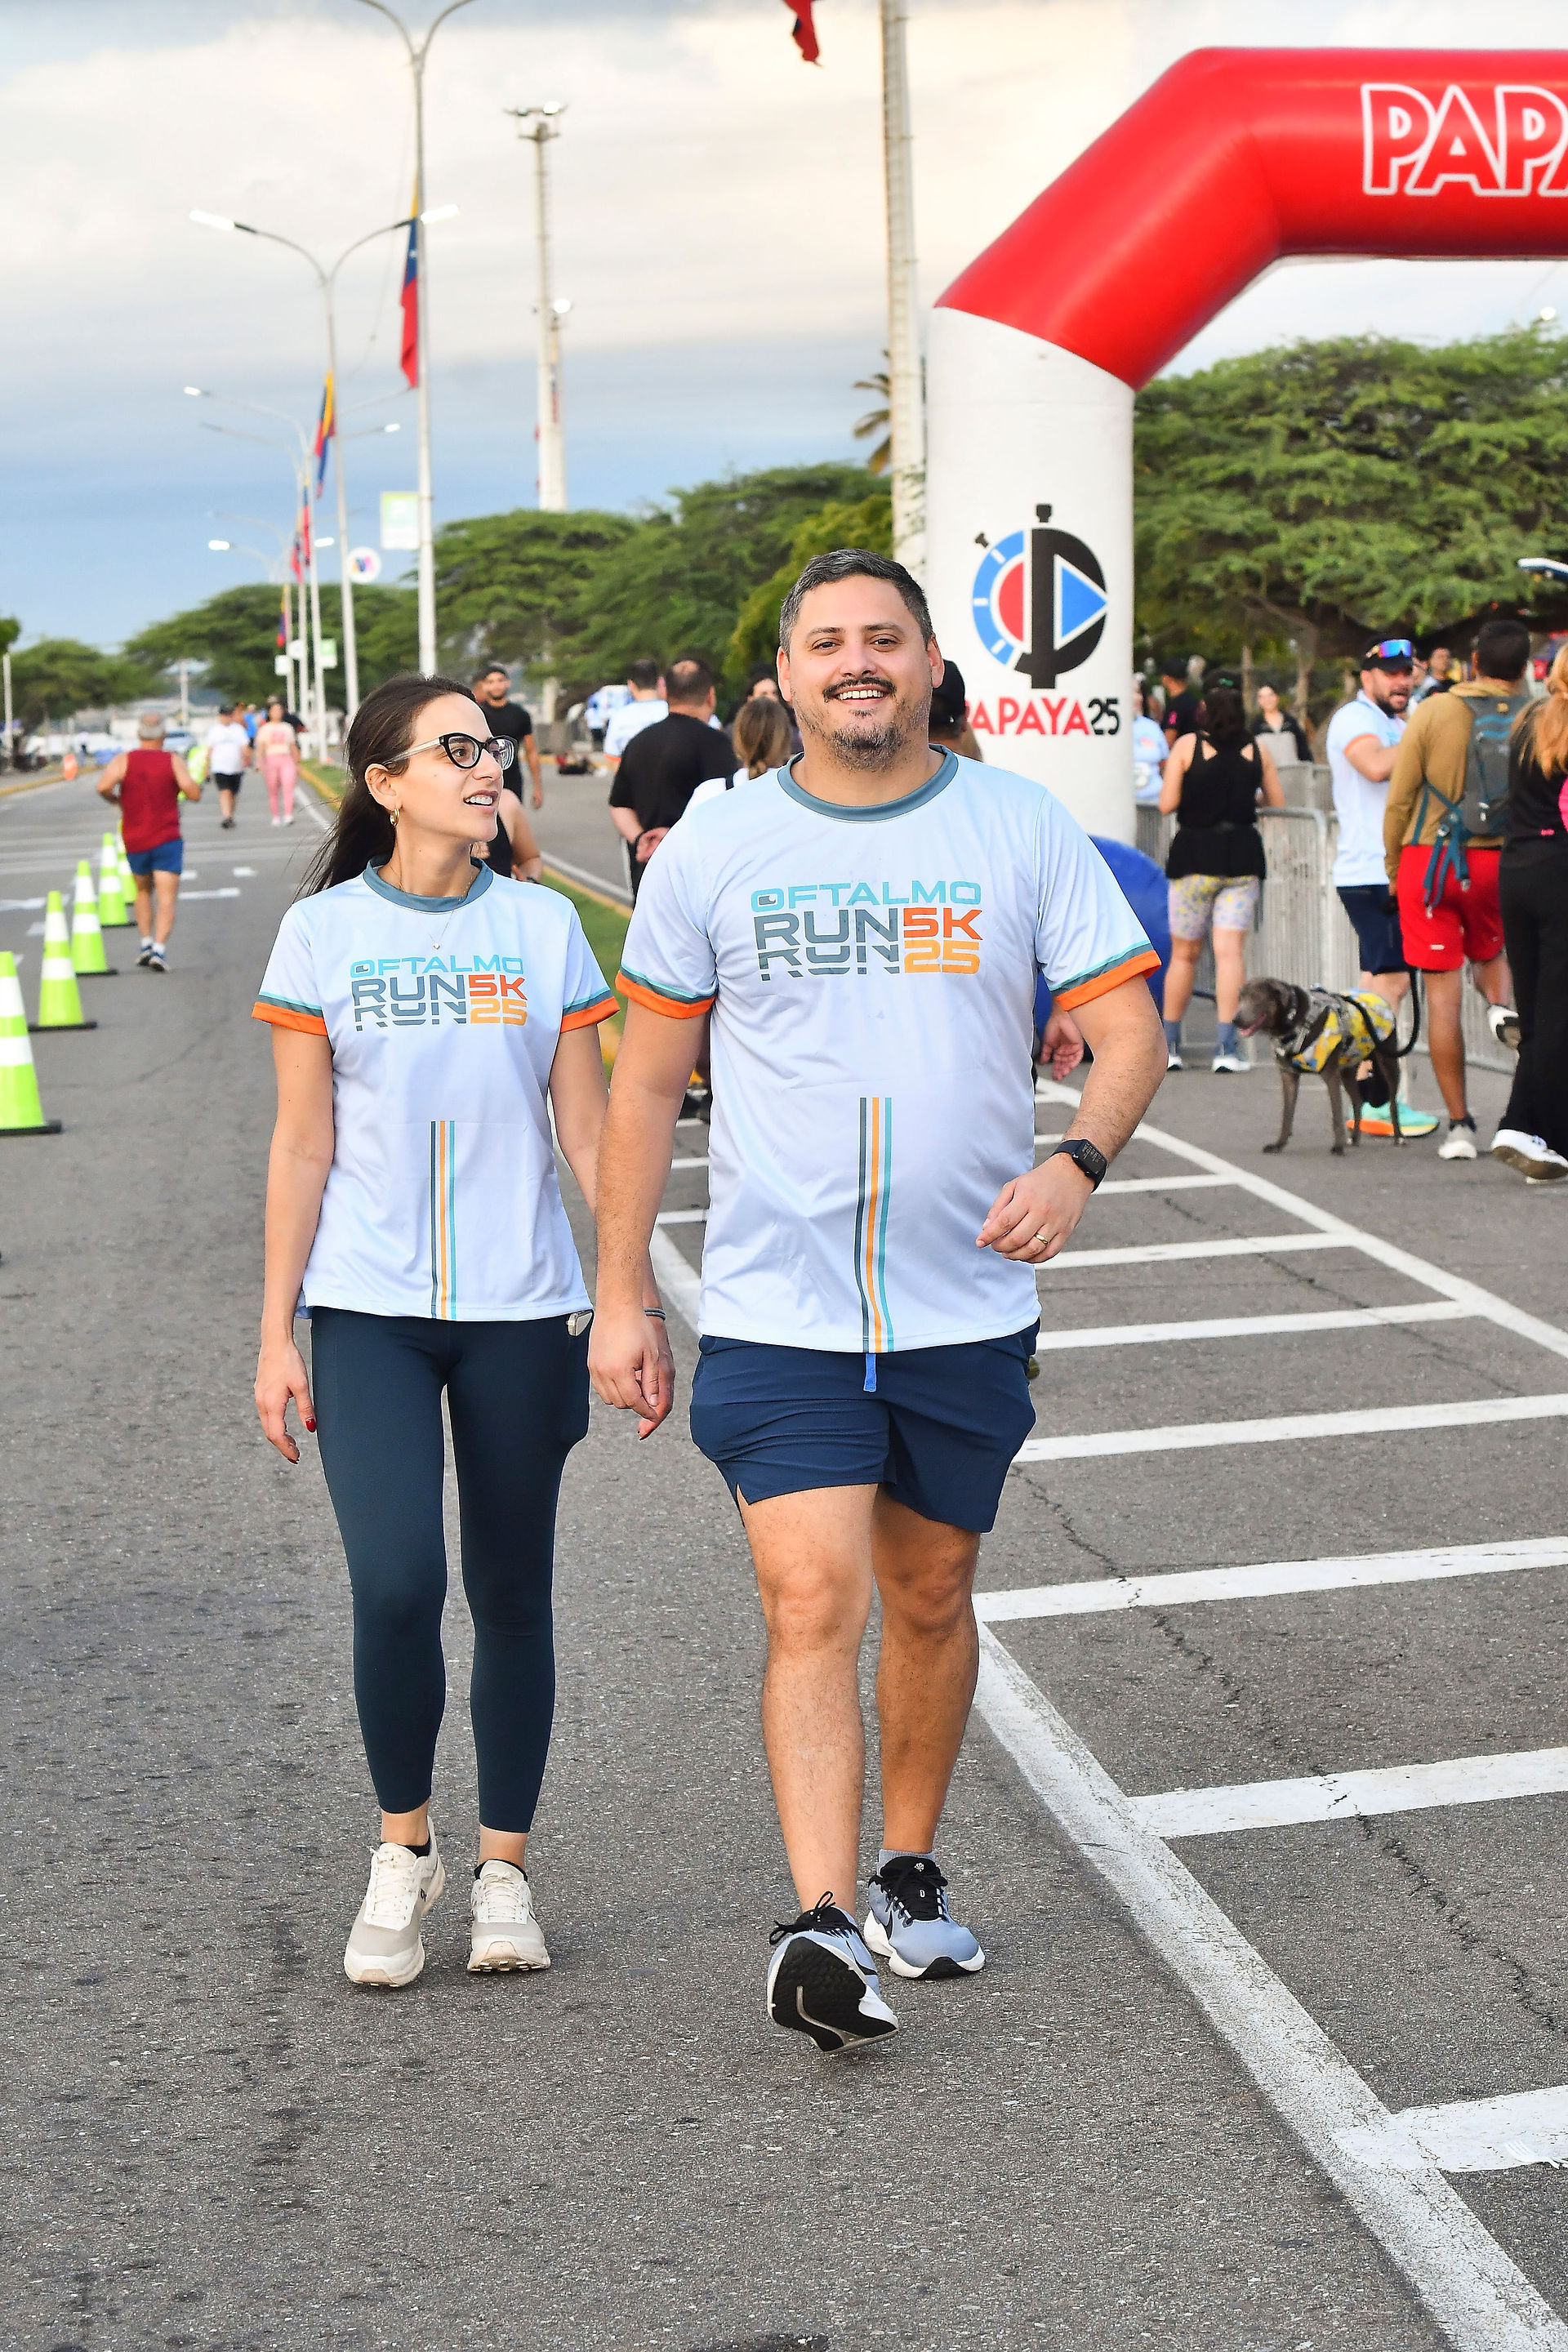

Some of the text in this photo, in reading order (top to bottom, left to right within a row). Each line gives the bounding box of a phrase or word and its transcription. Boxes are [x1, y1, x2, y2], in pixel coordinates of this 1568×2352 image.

[1361, 83, 1568, 197] PAP
[964, 697, 1120, 736] APAYA25
[751, 880, 982, 912] OFTALMO
[350, 954, 524, 978] OFTALMO
